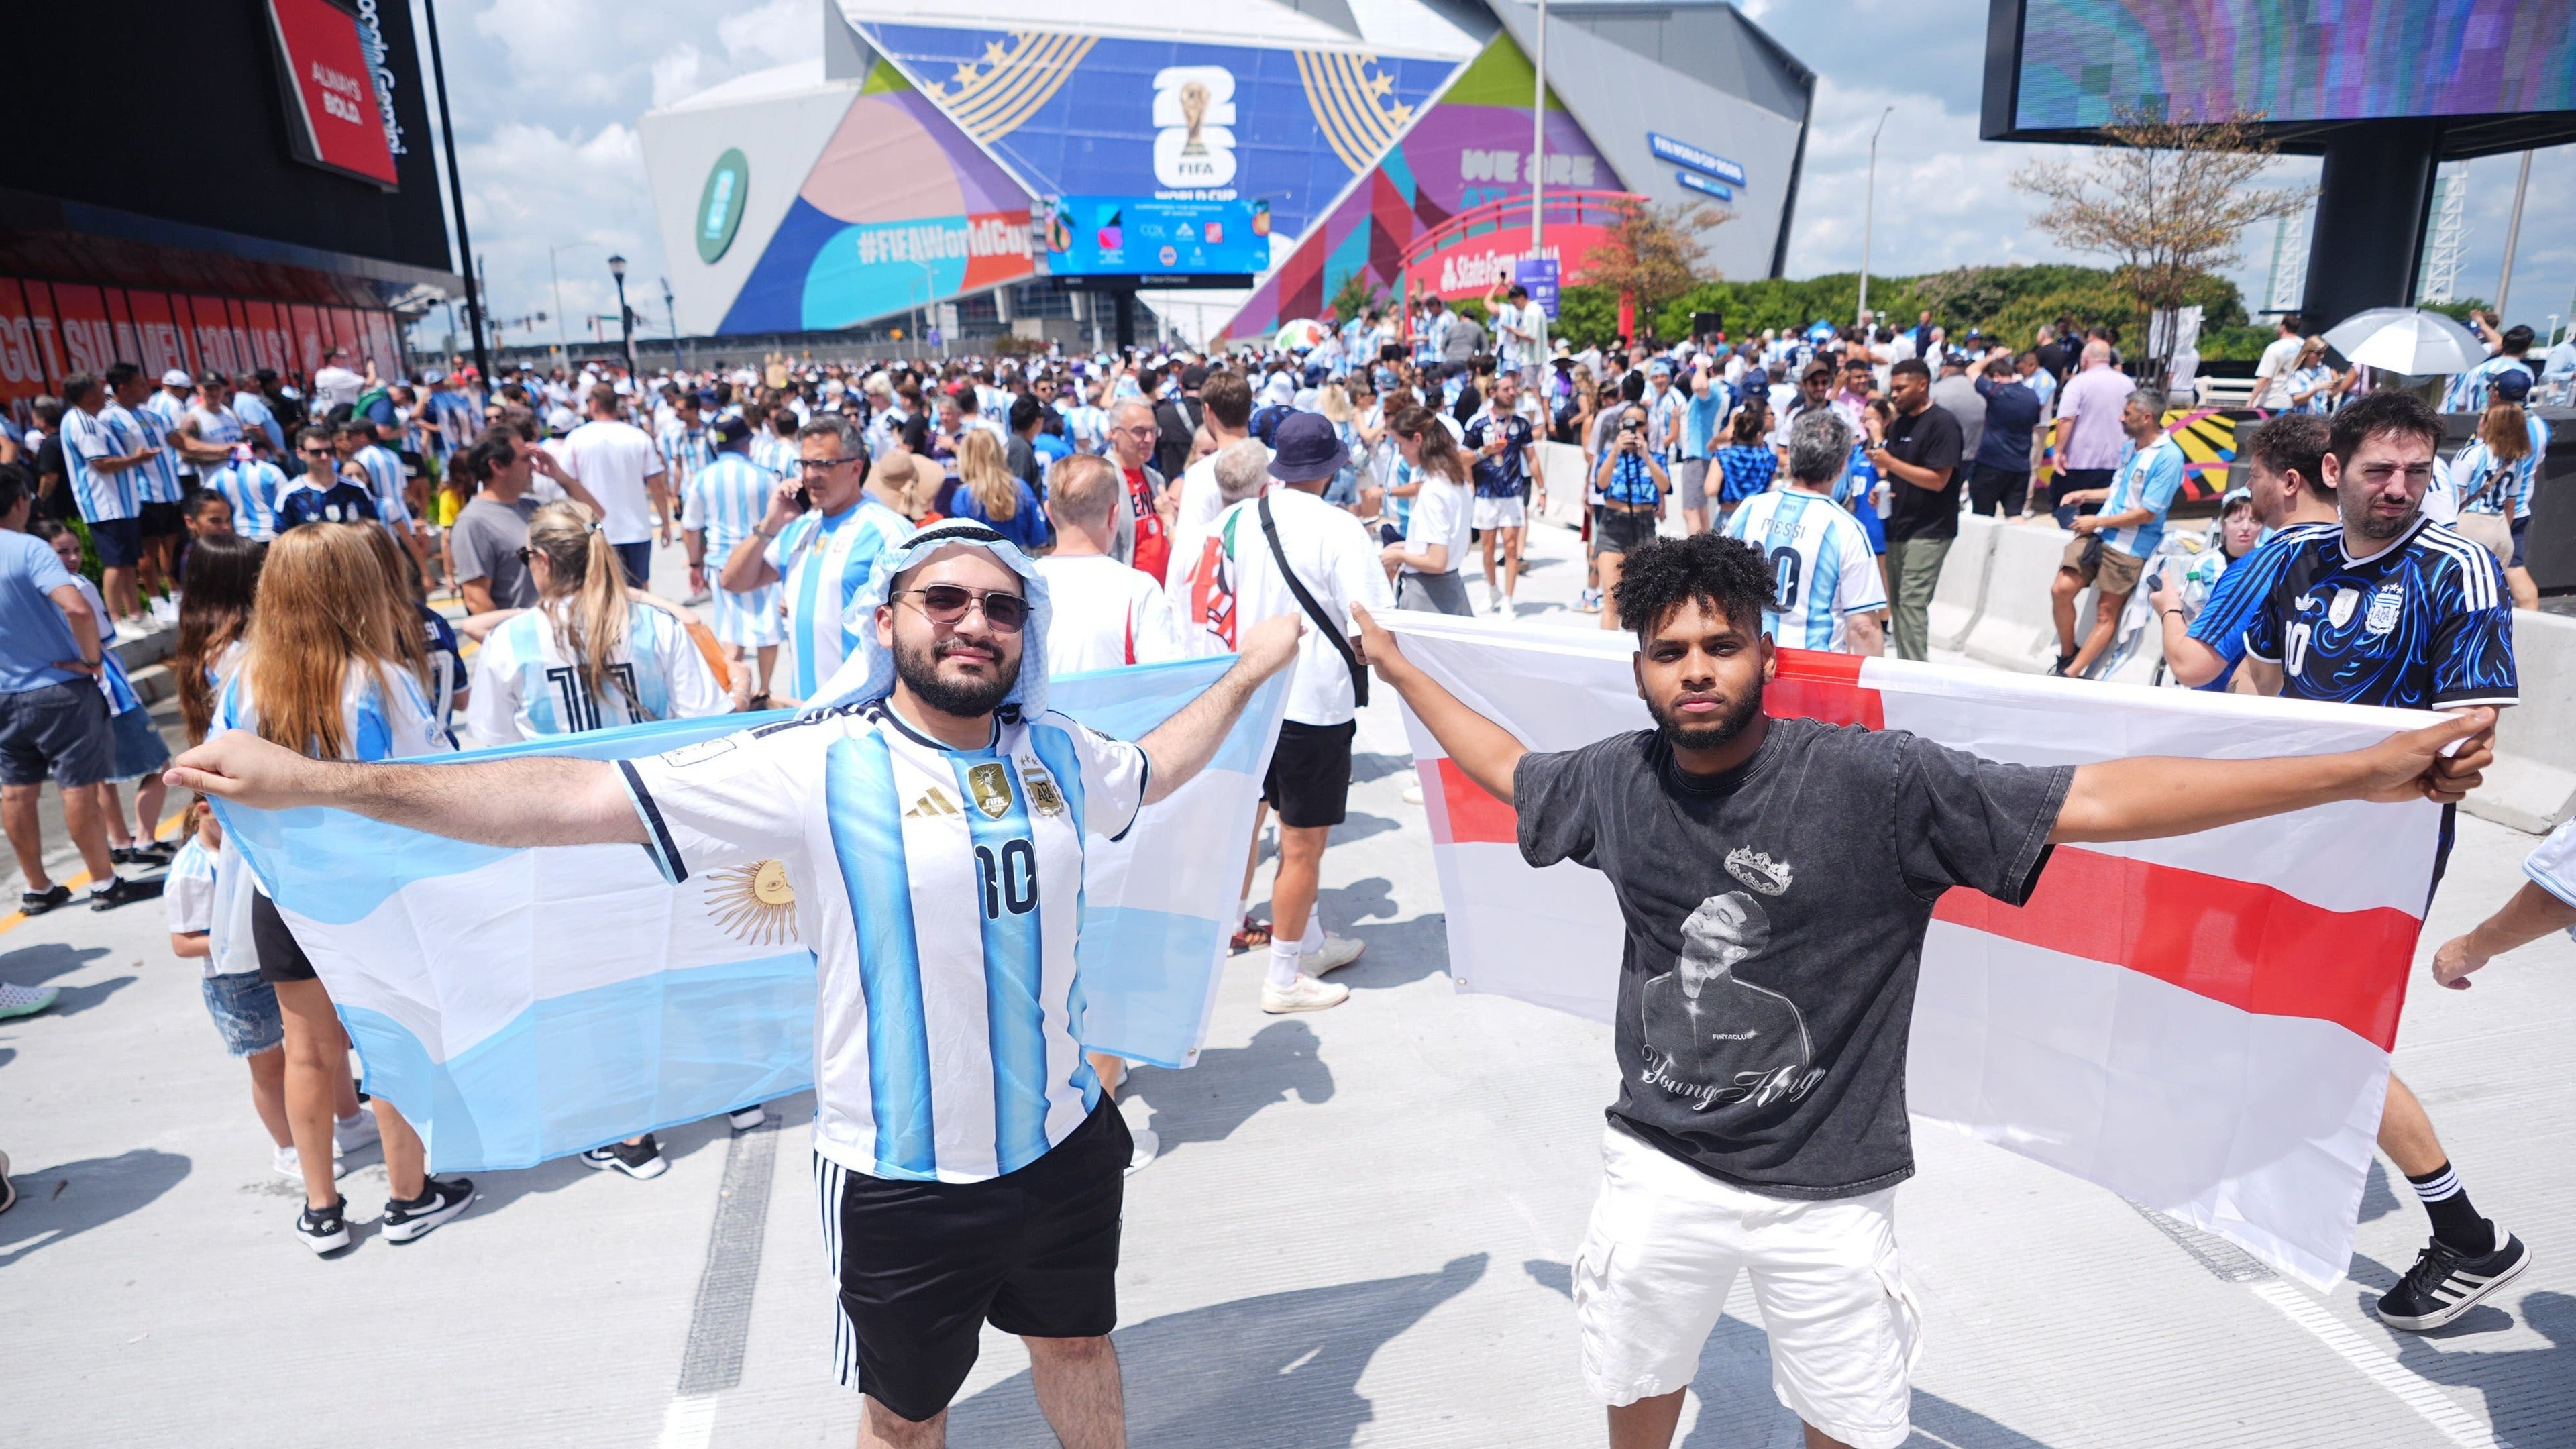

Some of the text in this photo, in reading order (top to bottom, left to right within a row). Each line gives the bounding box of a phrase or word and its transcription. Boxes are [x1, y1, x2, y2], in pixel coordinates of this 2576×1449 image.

[311, 60, 362, 102] ALWAYS
[1179, 162, 1214, 176] FIFA
[1460, 148, 1520, 183] WE
[857, 219, 1033, 264] #FIFAWorldCup
[0, 315, 62, 384] GOT
[1761, 517, 1807, 539] MESSI
[985, 796, 1005, 806] FIFA
[973, 838, 1039, 921] 10
[1642, 1044, 1718, 1111] Young
